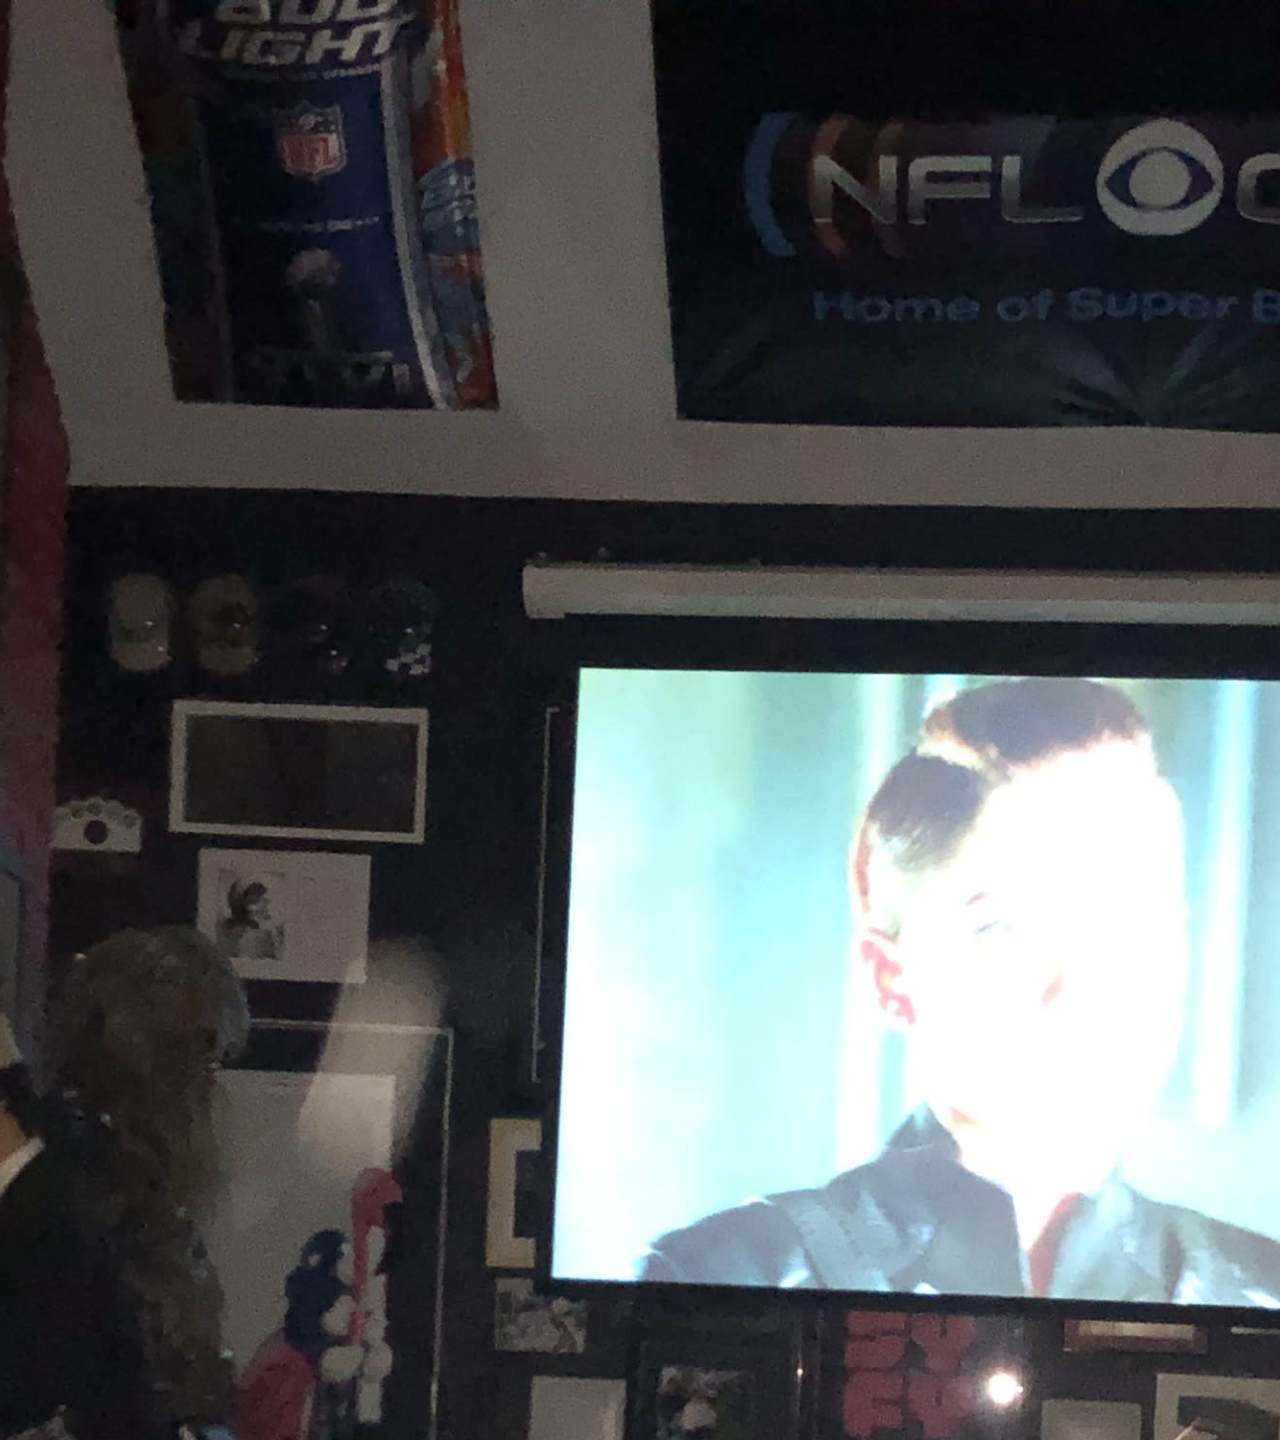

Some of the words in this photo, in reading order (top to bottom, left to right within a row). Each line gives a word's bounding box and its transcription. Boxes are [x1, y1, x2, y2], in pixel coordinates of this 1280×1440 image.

[177, 12, 417, 66] LIGHT
[813, 154, 1087, 225] NFL
[812, 288, 981, 323] Home
[995, 287, 1054, 322] of
[1064, 286, 1238, 325] Super
